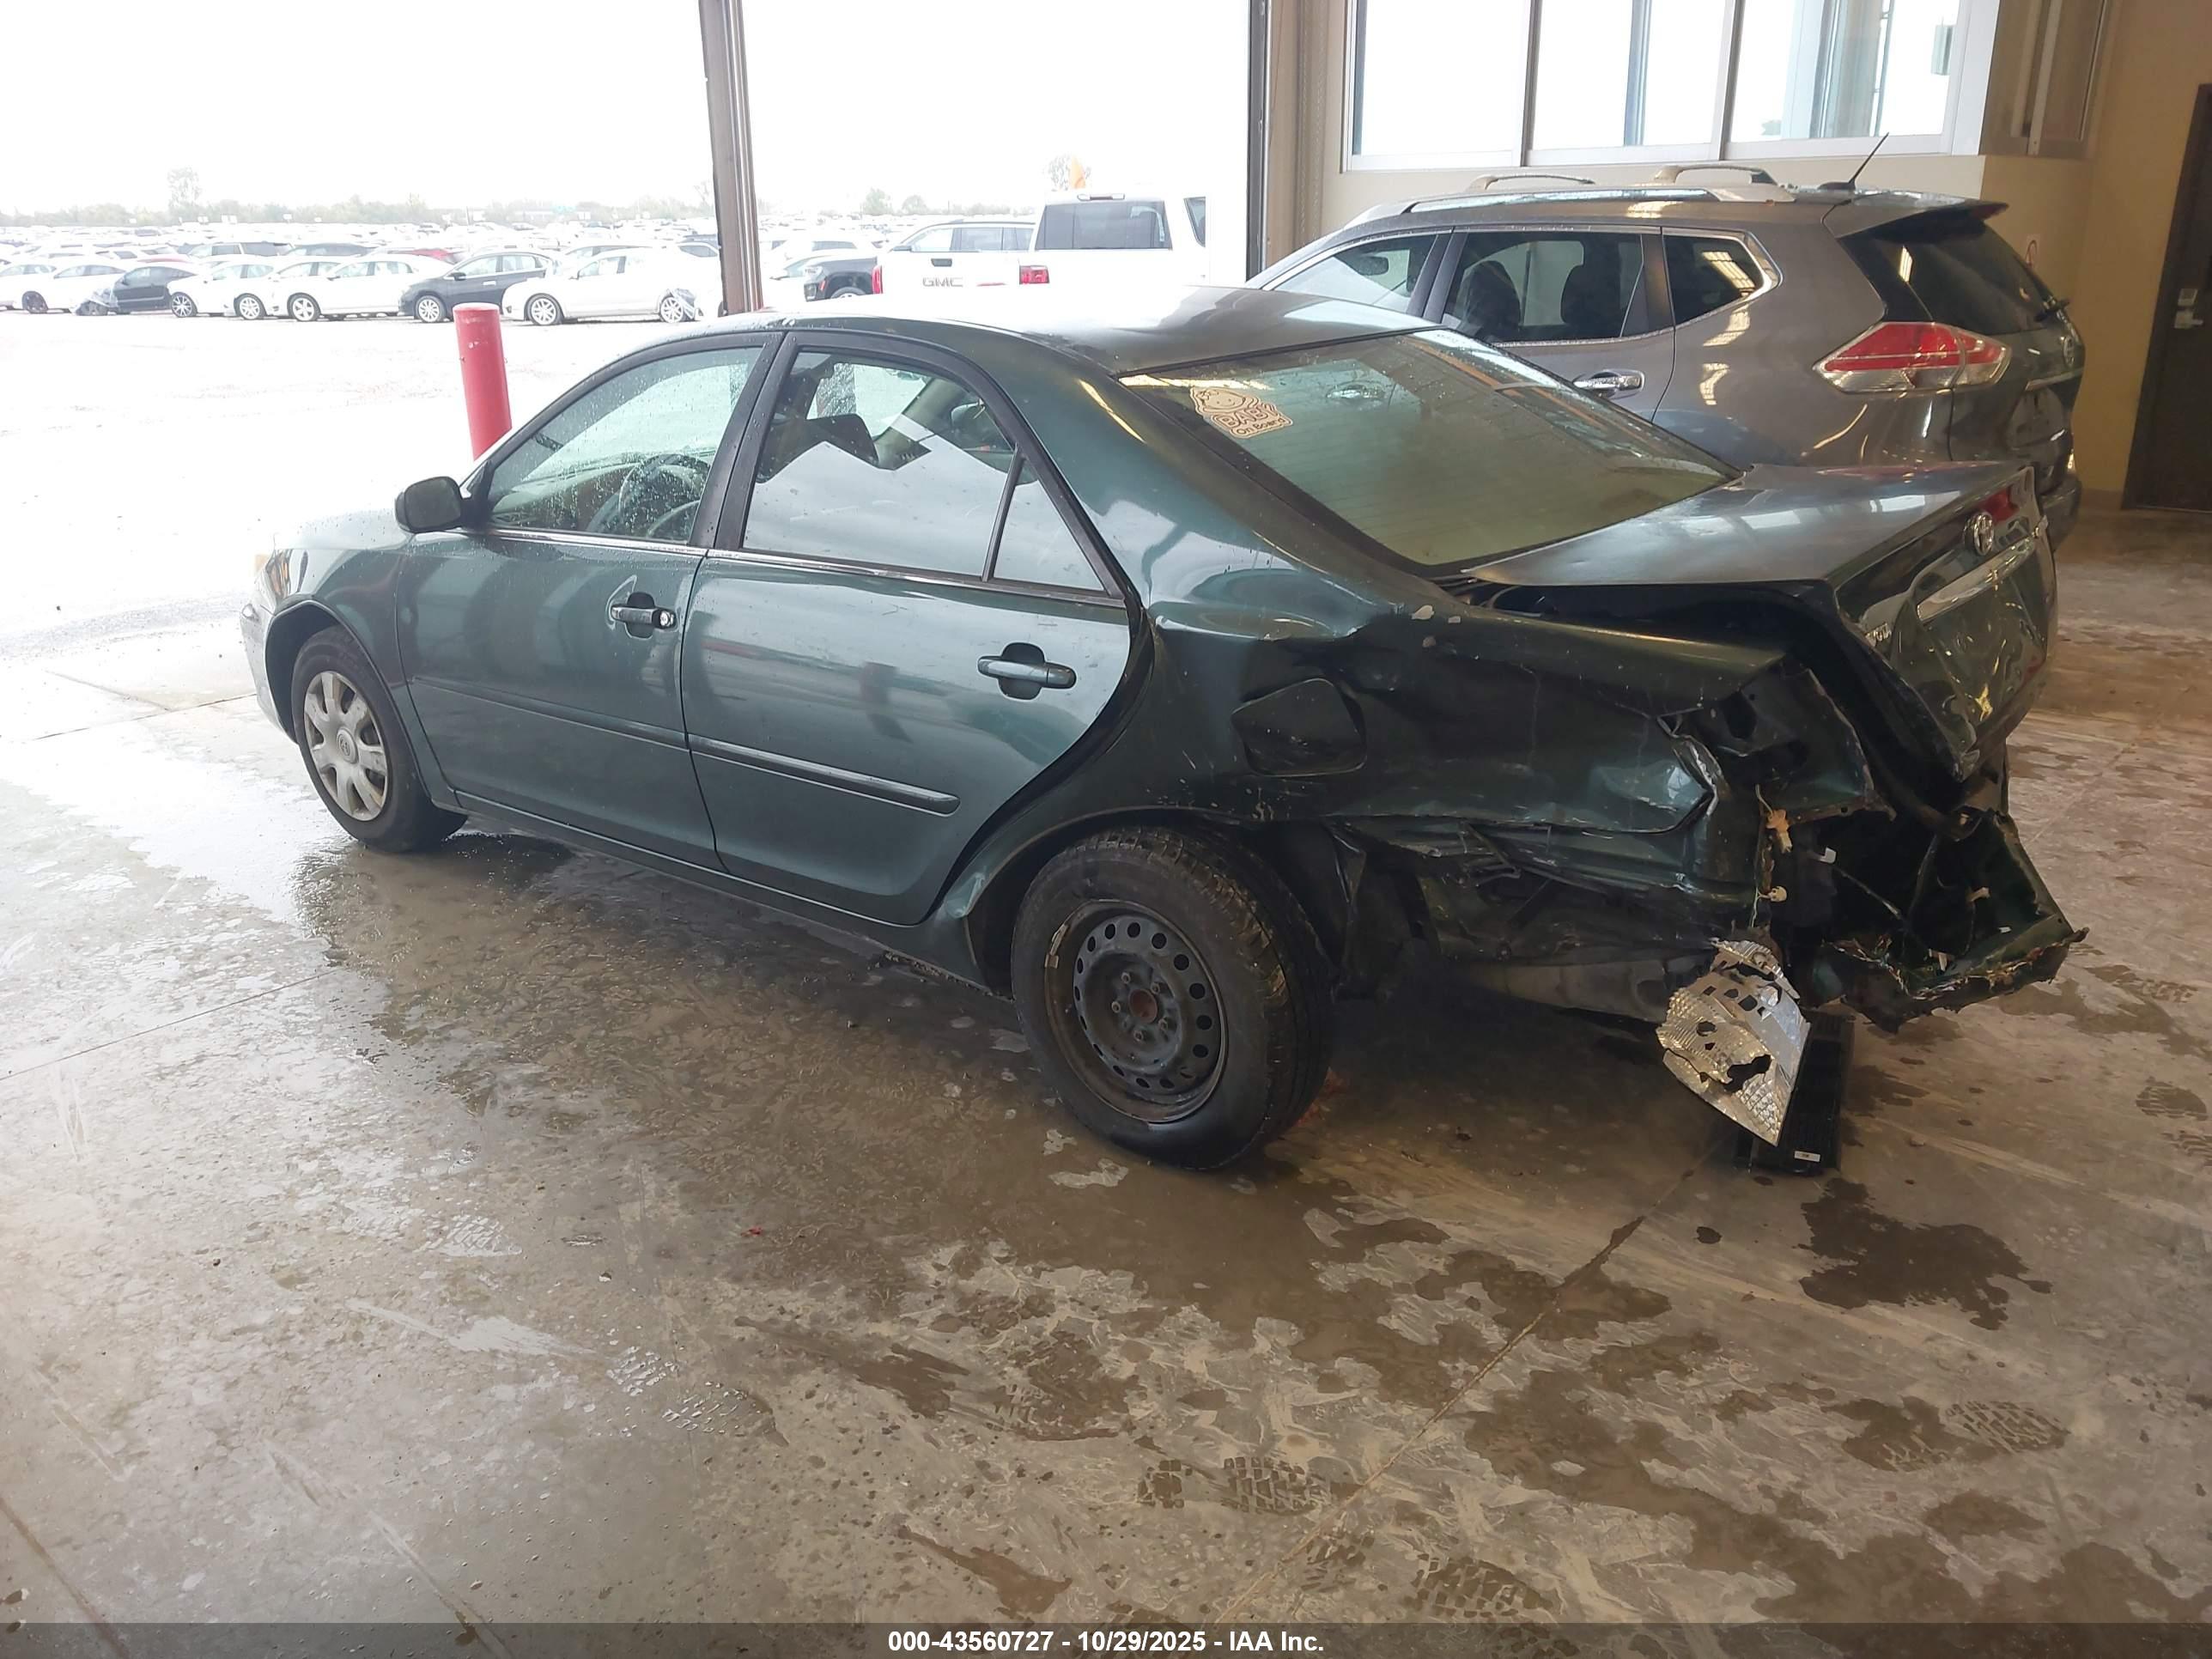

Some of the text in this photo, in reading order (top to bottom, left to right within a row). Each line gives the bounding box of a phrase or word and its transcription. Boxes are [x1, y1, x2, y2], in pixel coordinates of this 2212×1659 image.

[921, 276, 963, 288] GMC
[1213, 404, 1279, 428] BABY
[1253, 418, 1285, 429] Board
